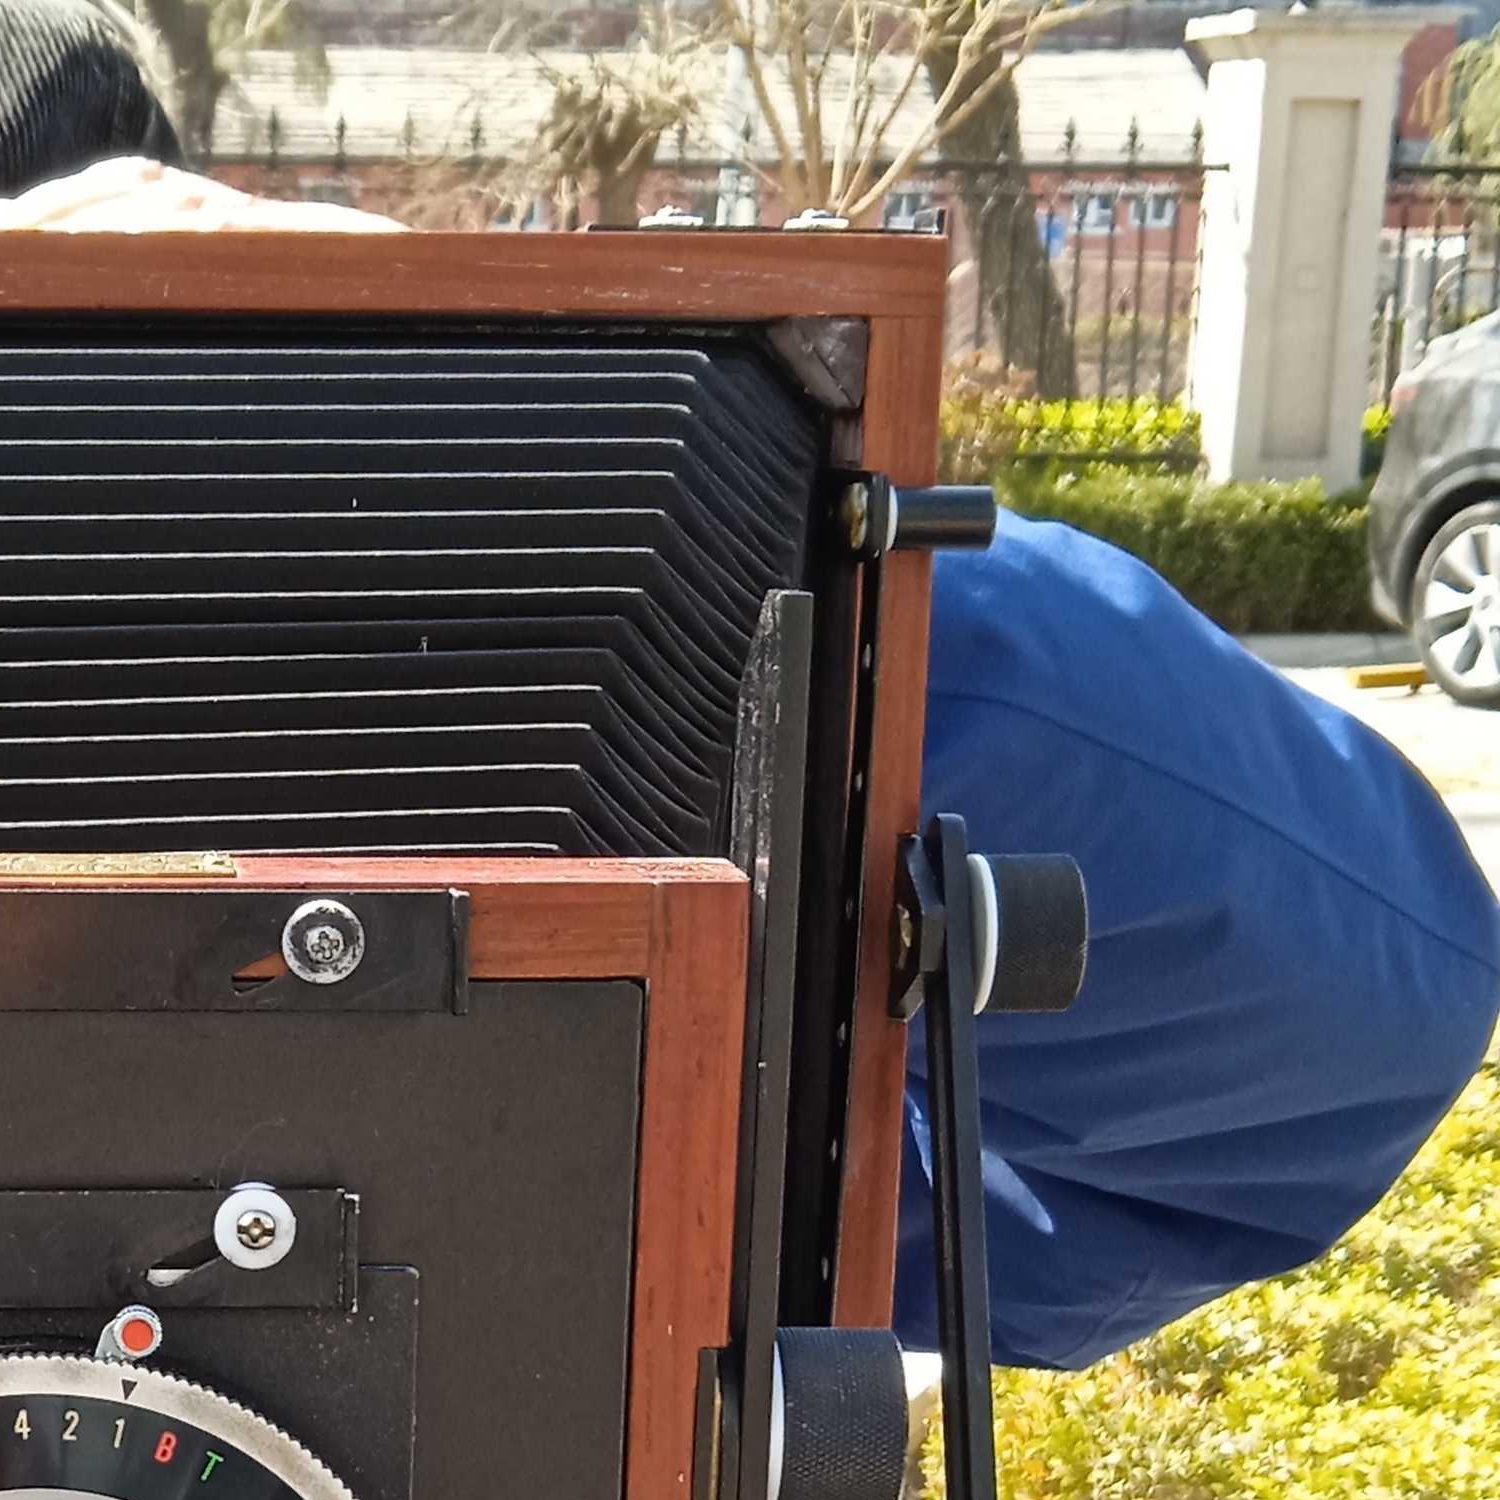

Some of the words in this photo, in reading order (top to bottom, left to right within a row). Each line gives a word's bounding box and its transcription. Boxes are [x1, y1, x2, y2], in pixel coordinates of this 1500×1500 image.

[14, 1409, 32, 1440] 4
[62, 1410, 80, 1441] 2
[114, 1418, 125, 1449] 1
[154, 1431, 178, 1463] B
[201, 1450, 224, 1481] T
